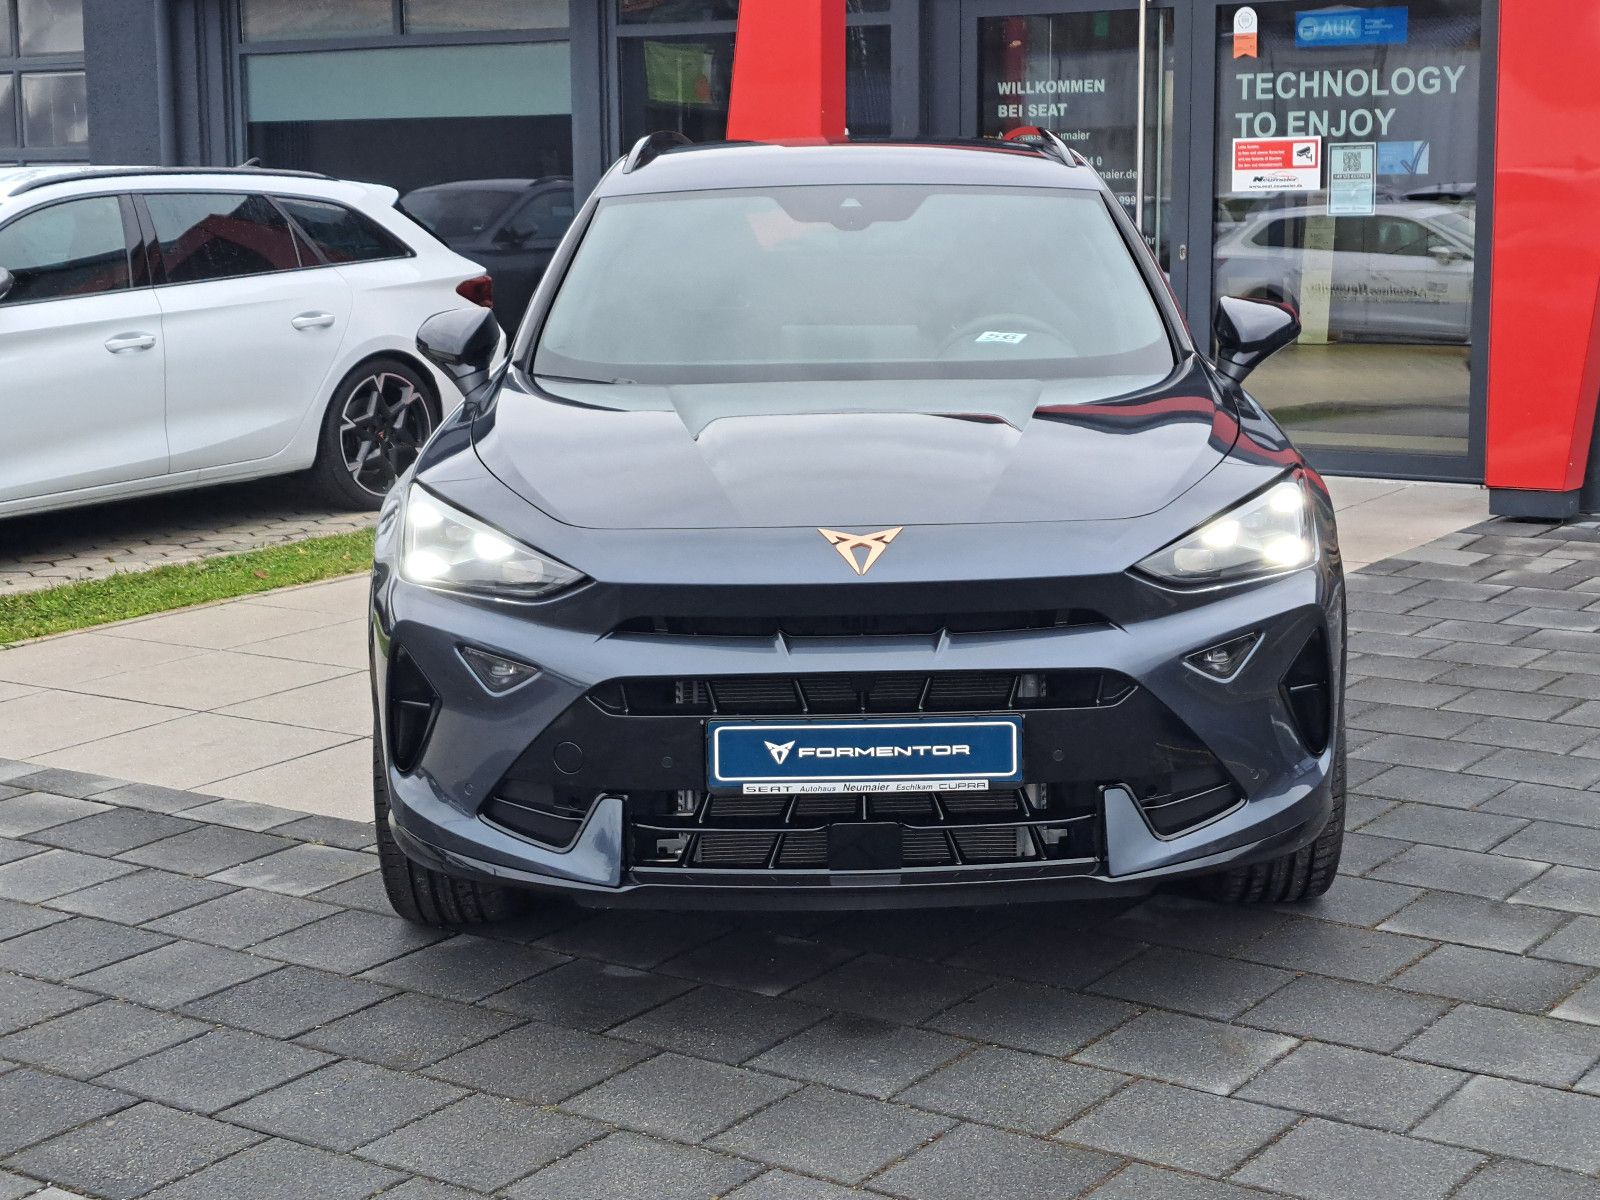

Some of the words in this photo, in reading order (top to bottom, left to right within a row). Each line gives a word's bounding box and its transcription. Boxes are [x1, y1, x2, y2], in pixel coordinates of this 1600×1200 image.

[997, 79, 1105, 95] WILLKOMMEN
[1235, 65, 1466, 101] TECHNOLOGY
[998, 104, 1023, 118] BEI
[1028, 103, 1068, 117] SEAT
[1235, 111, 1277, 138] TO
[1287, 108, 1396, 138] ENJOY
[798, 744, 971, 758] FORMENTOR
[745, 785, 793, 793] SEAT
[799, 784, 837, 793] Autohaus
[842, 782, 891, 792] Neumaier
[938, 781, 986, 790] CUPRA
